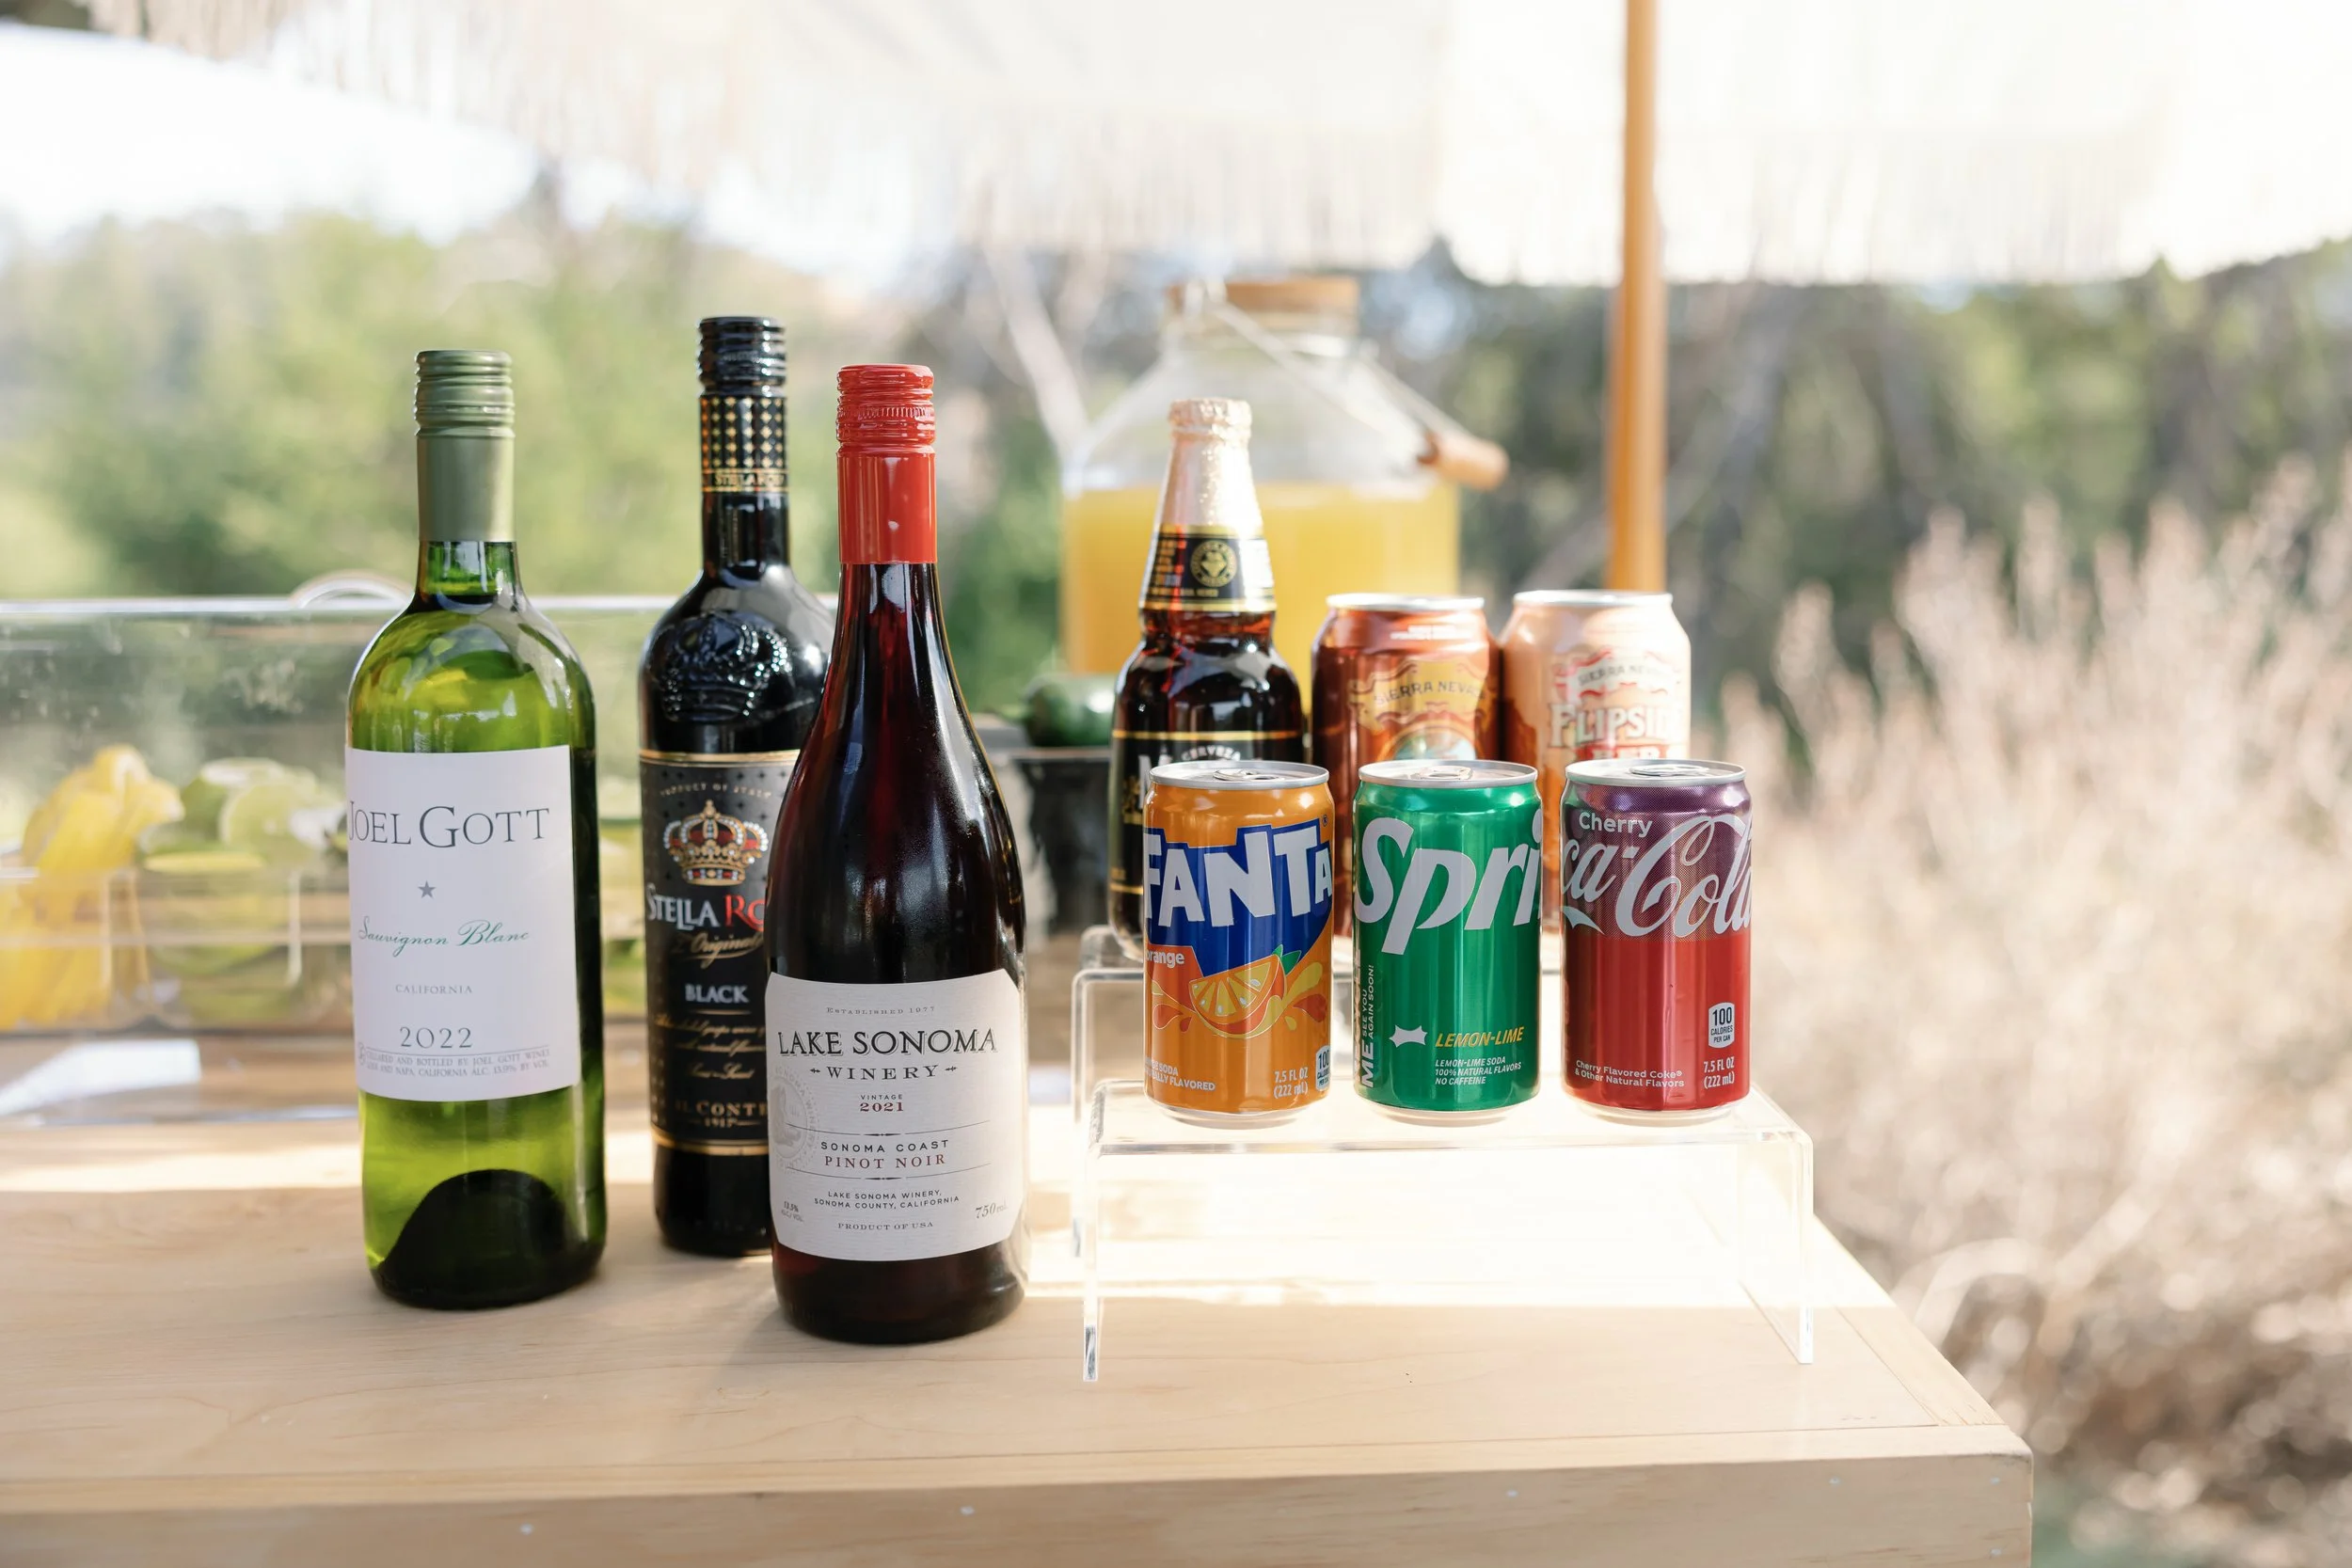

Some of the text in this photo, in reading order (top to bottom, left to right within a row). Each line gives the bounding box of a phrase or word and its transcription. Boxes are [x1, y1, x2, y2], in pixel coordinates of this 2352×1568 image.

[349, 800, 549, 847] JOEL GOTT
[1579, 812, 1653, 838] Cherry
[1145, 830, 1332, 927] FANTA
[647, 883, 721, 930] STELLA
[358, 915, 530, 958] Sauvignon Blanc
[395, 984, 473, 995] CALIFORNIA
[686, 984, 750, 1003] BLACK
[1712, 1006, 1733, 1026] 100
[400, 1026, 473, 1050] 2022
[1435, 1026, 1525, 1048] LEMON-LIME
[1710, 1024, 1734, 1036] CALORIES
[778, 1031, 844, 1056] LAKE
[852, 1027, 998, 1055] SONOMA
[1713, 1036, 1723, 1044] PER
[416, 1056, 453, 1067] BOTTLED
[457, 1057, 469, 1067] BY
[472, 1055, 493, 1068] JOEL
[498, 1053, 521, 1064] GOTT
[1360, 1039, 1375, 1089] ME
[1435, 1055, 1506, 1068] LEMON-LIME SODA
[1457, 1067, 1493, 1076] NATURAL
[1493, 1061, 1522, 1074] FLAVORS
[1703, 1055, 1735, 1073] 7.5 FL OZ
[418, 1068, 469, 1077] CALIFORNIA
[826, 1064, 939, 1081] WINERY
[1159, 1061, 1179, 1077] SODA
[1274, 1069, 1288, 1084] 7.5
[1288, 1069, 1298, 1082] FL
[1298, 1067, 1310, 1080] OZ
[1576, 1059, 1602, 1073] Cherry
[1603, 1066, 1647, 1079] Flavored
[1169, 1076, 1216, 1092] FLAVORED
[1435, 1076, 1486, 1085] NO CAFFEINE
[1574, 1068, 1685, 1087] & Other Natural Flavors
[1703, 1069, 1735, 1090] (222 mL)
[1273, 1084, 1293, 1100] (222
[860, 1101, 904, 1112] 2021
[820, 1139, 949, 1153] SONOMA COAST
[824, 1153, 946, 1169] PINOT NOIR
[828, 1191, 850, 1199] LAKE
[901, 1189, 942, 1199] WINERY,
[814, 1197, 851, 1209] SONOMA
[899, 1196, 960, 1209] CALIFORNIA
[838, 1222, 891, 1231] PRODUCT
[912, 1221, 934, 1230] USA
